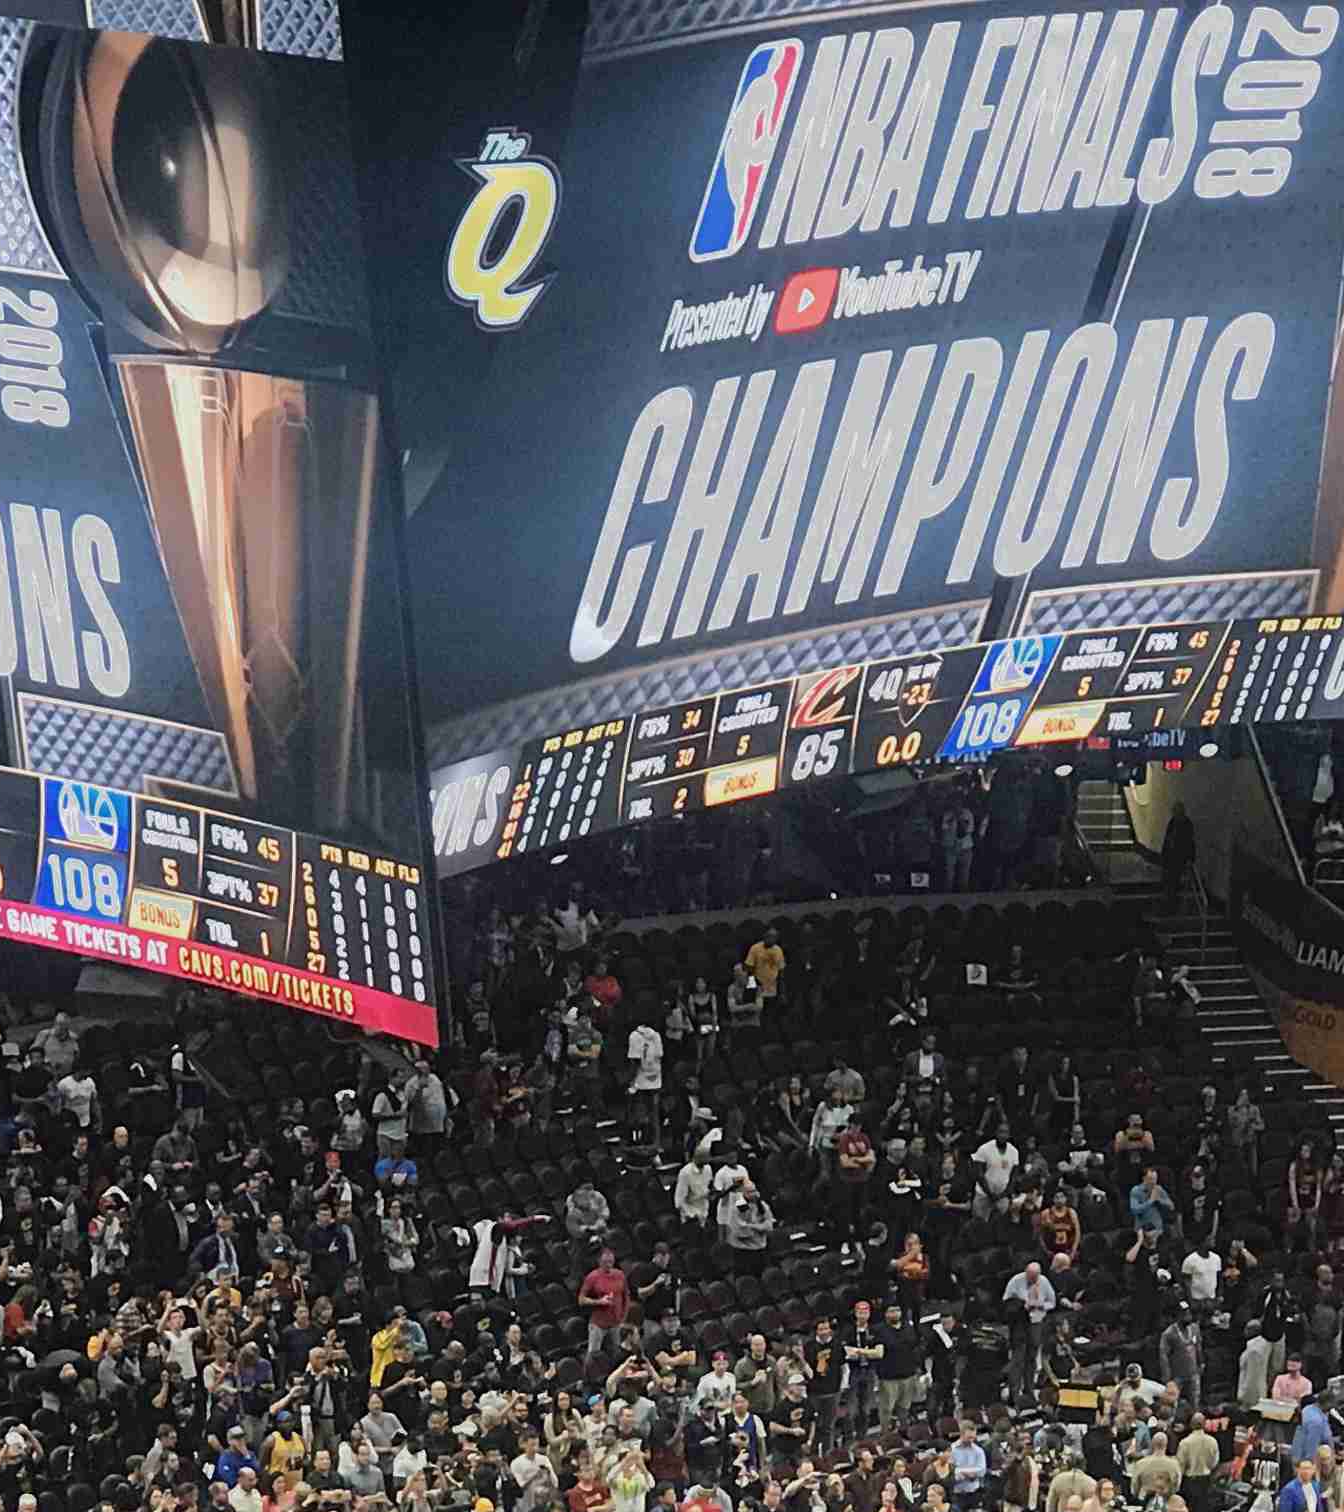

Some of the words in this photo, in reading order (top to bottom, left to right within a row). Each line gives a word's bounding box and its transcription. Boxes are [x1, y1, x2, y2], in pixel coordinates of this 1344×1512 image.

[1193, 4, 1340, 199] 2018
[757, 24, 950, 250] NBA
[928, 4, 1234, 228] FINALS
[479, 132, 527, 161] The
[448, 161, 557, 326] Q
[661, 293, 748, 352] Presented
[569, 312, 1276, 665] CHAMPIONS
[1077, 676, 1092, 697] 5
[956, 699, 1021, 751] 108
[736, 735, 751, 756] 5
[790, 728, 845, 782] 85
[876, 730, 922, 766] 0.0
[673, 787, 689, 810] 2
[257, 837, 280, 862] 45
[47, 854, 121, 917] 108
[162, 857, 179, 887] 5
[302, 862, 313, 882] 2
[257, 882, 279, 907] 37
[140, 902, 180, 929] BONUS
[7, 906, 59, 942] GAME
[63, 919, 141, 961] TICKETS
[146, 940, 168, 965] AT
[336, 937, 348, 958] 2
[307, 952, 326, 974] 27
[338, 960, 350, 981] 2
